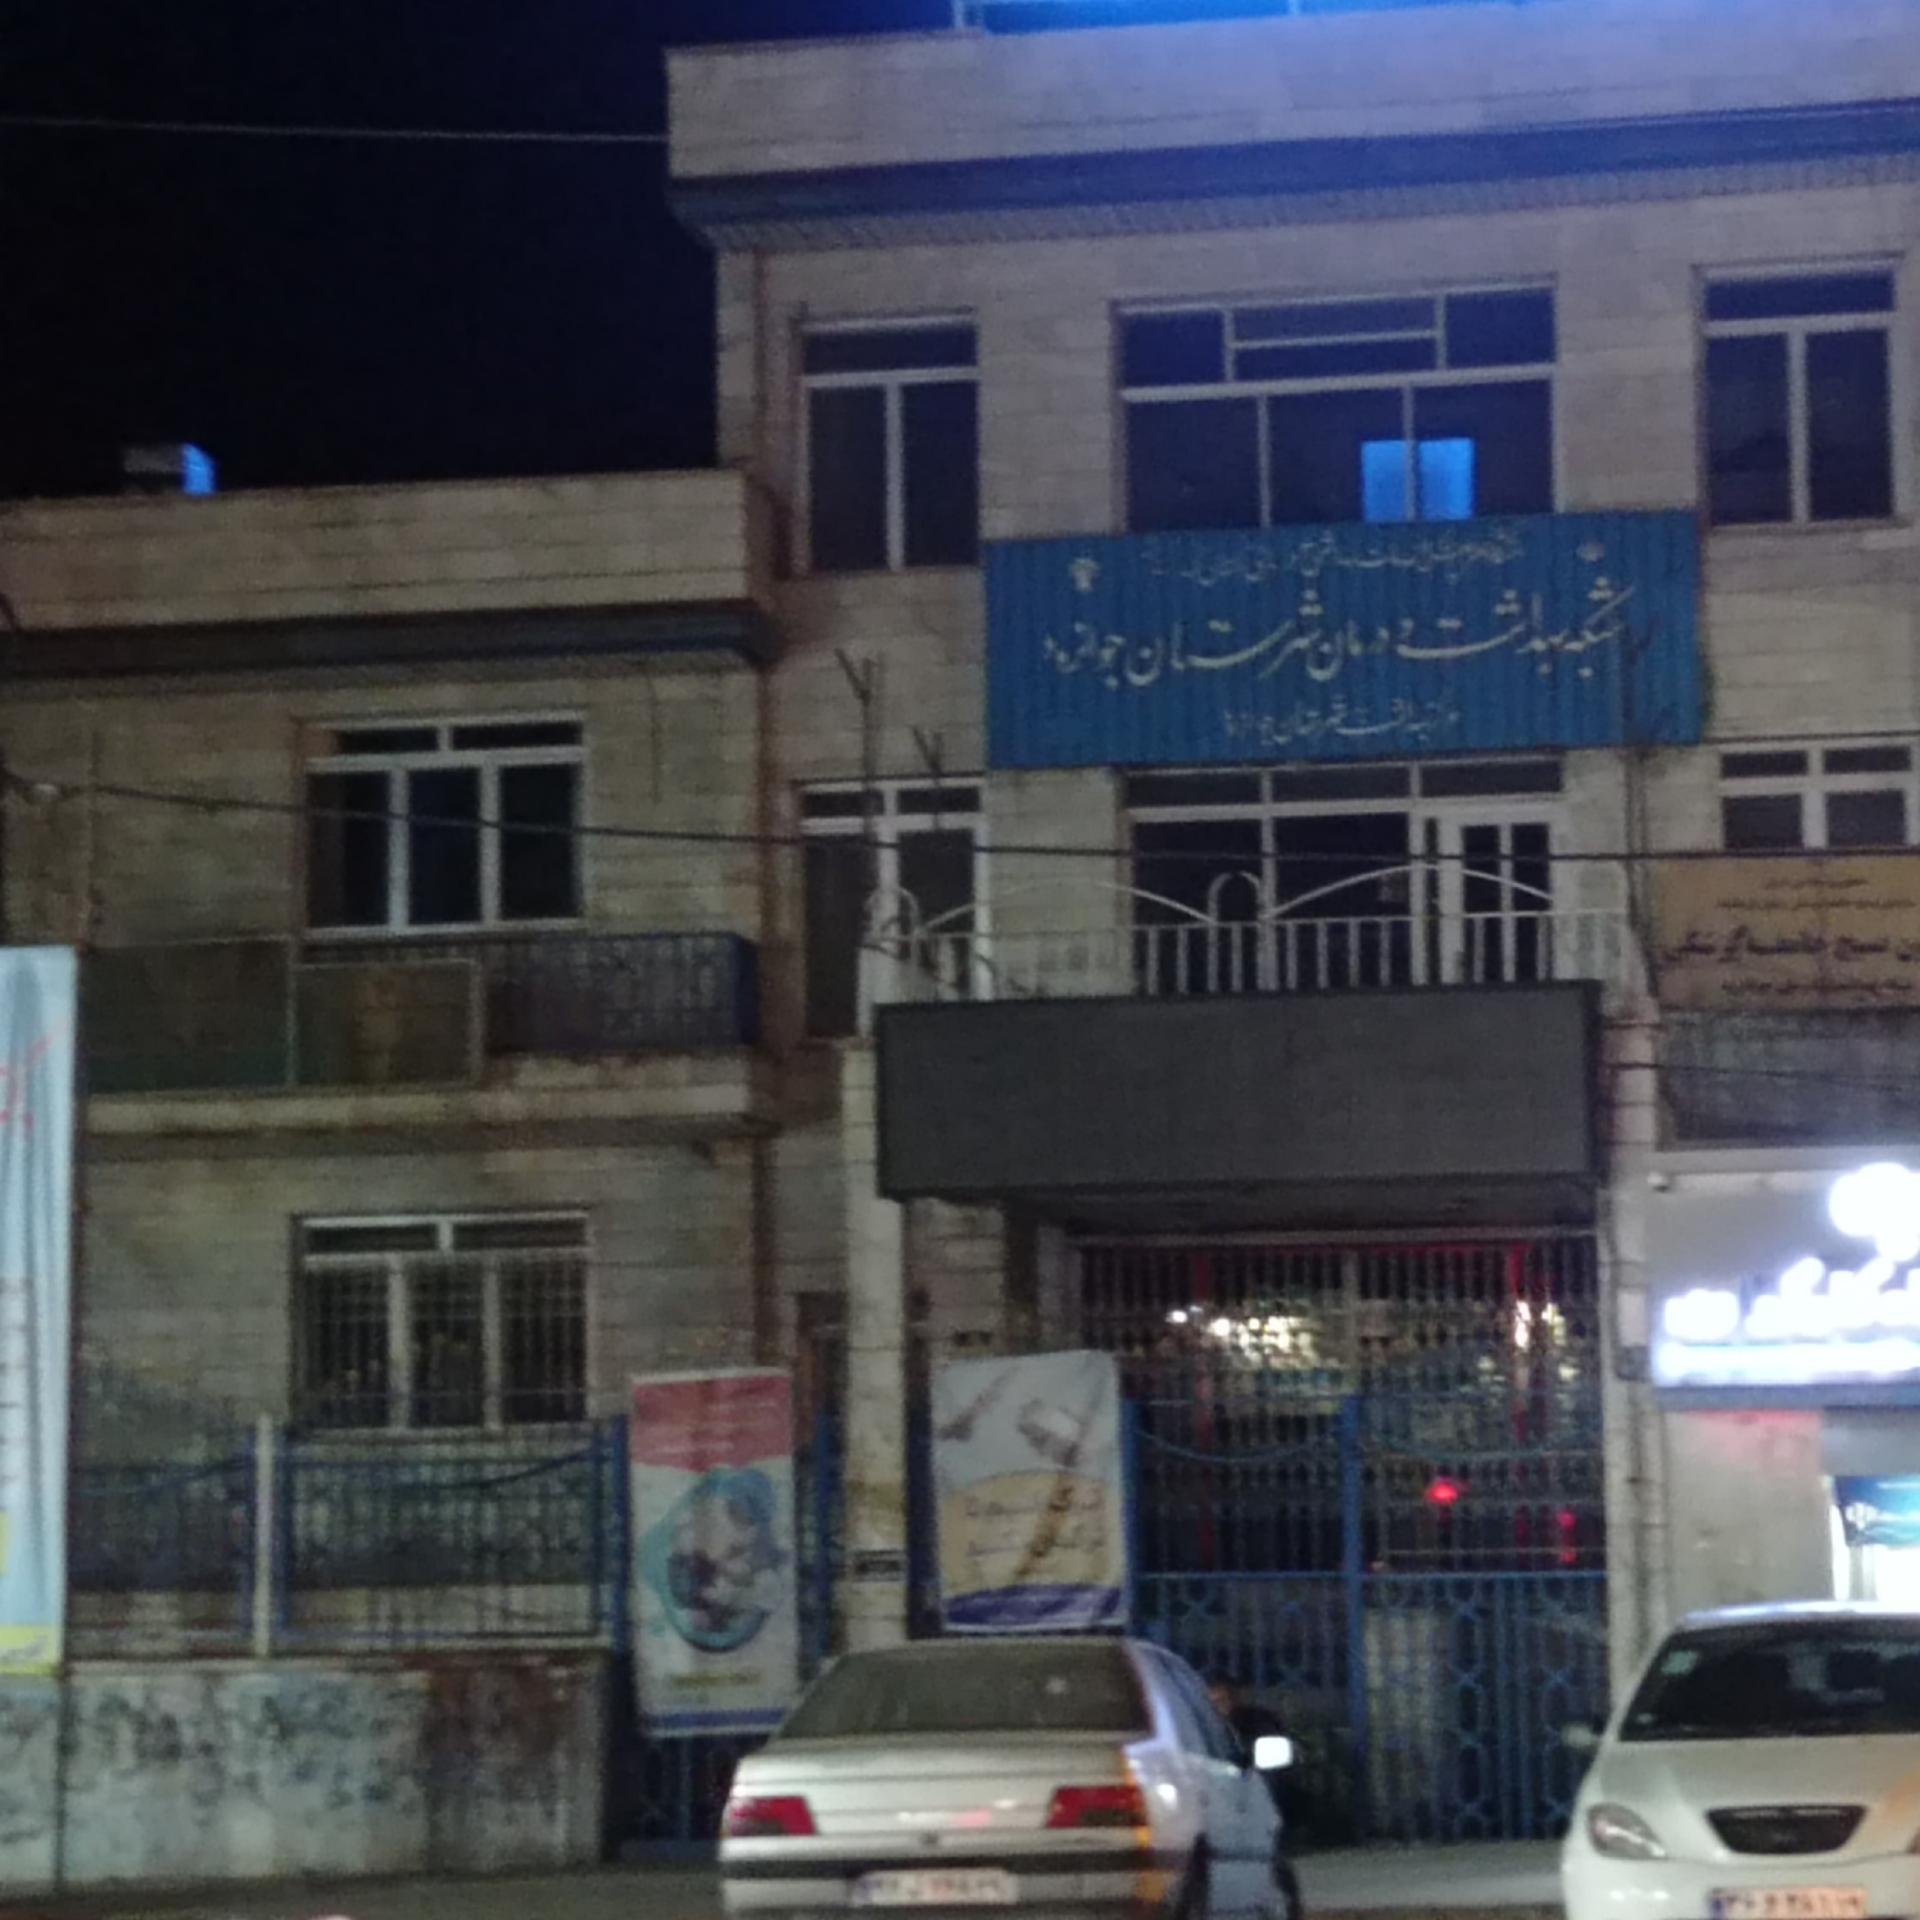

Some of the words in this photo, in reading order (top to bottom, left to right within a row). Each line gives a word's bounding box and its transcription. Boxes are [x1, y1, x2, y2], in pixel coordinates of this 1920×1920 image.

[1124, 588, 1324, 688] شهرستان
[1305, 616, 1393, 681] درمان
[1397, 590, 1570, 676] بهداشت
[1560, 576, 1636, 678] شبکه
